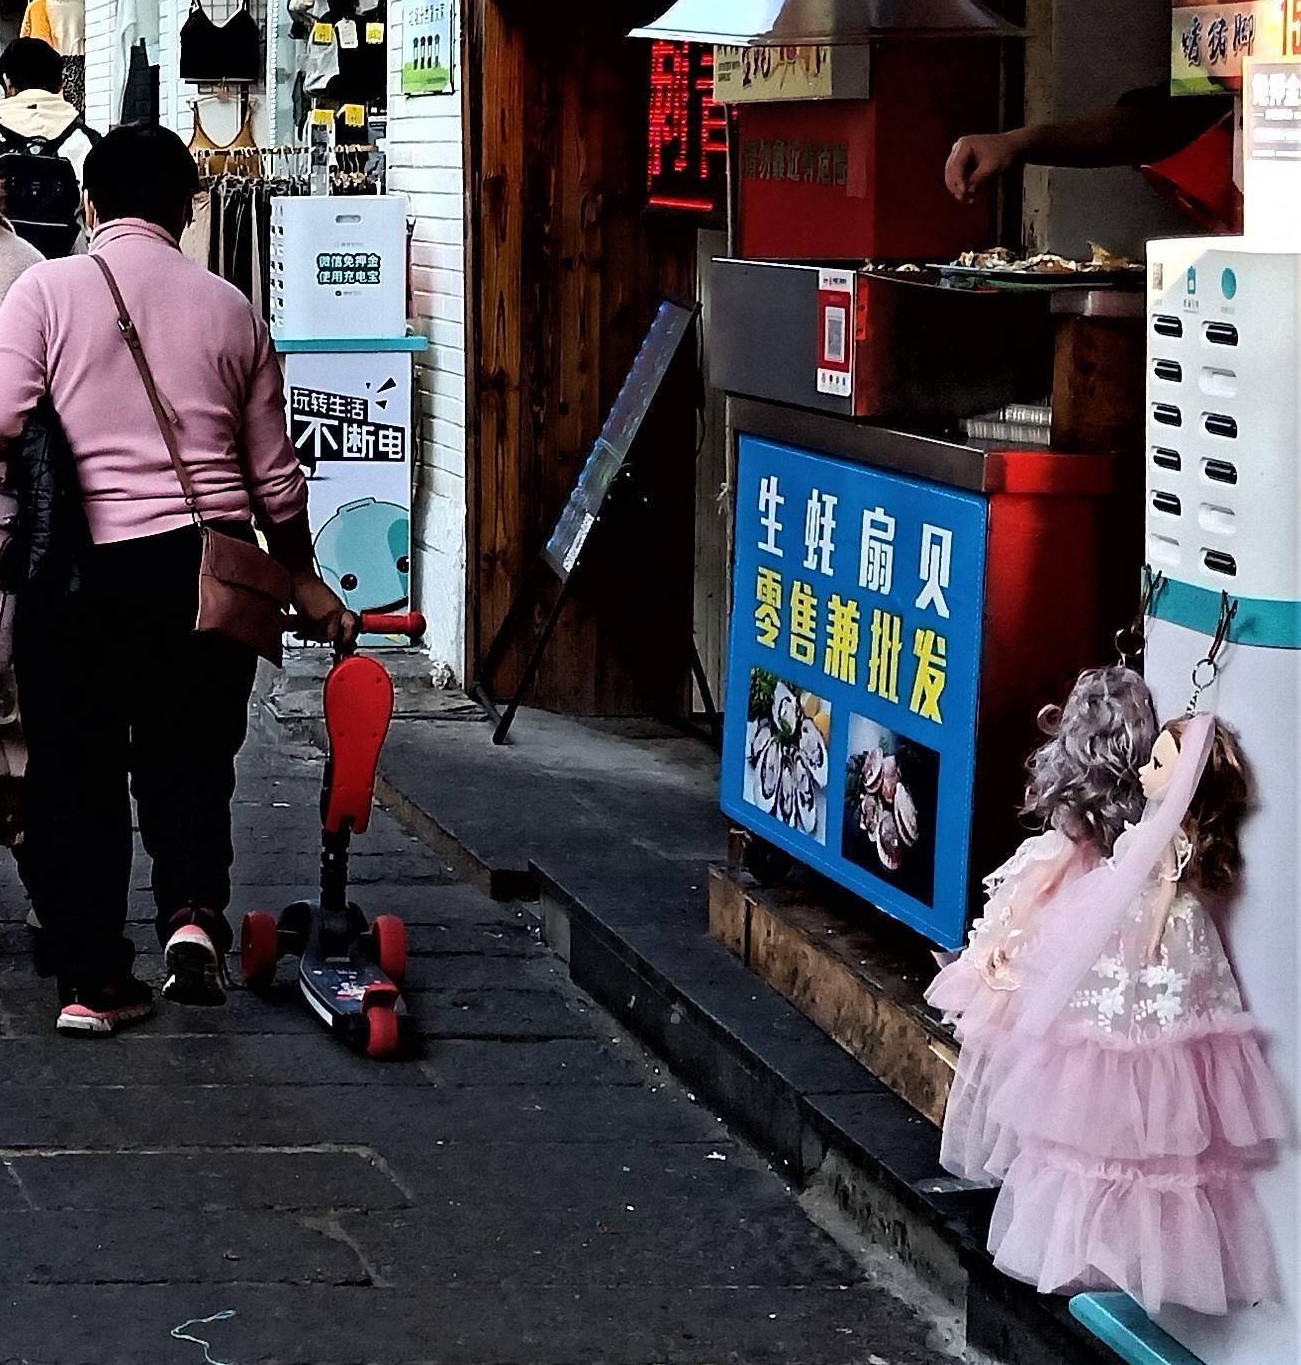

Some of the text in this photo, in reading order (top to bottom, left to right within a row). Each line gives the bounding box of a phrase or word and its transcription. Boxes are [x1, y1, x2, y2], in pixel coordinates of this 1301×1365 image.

[1181, 12, 1256, 68] 烤猪脚
[318, 253, 381, 269] 微信免押金
[318, 270, 381, 284] 使用充电宝
[292, 389, 365, 420] 玩转生活
[293, 414, 403, 459] 不断电
[756, 474, 954, 621] 生蚝扇贝
[754, 566, 949, 725] 零售兼批发
